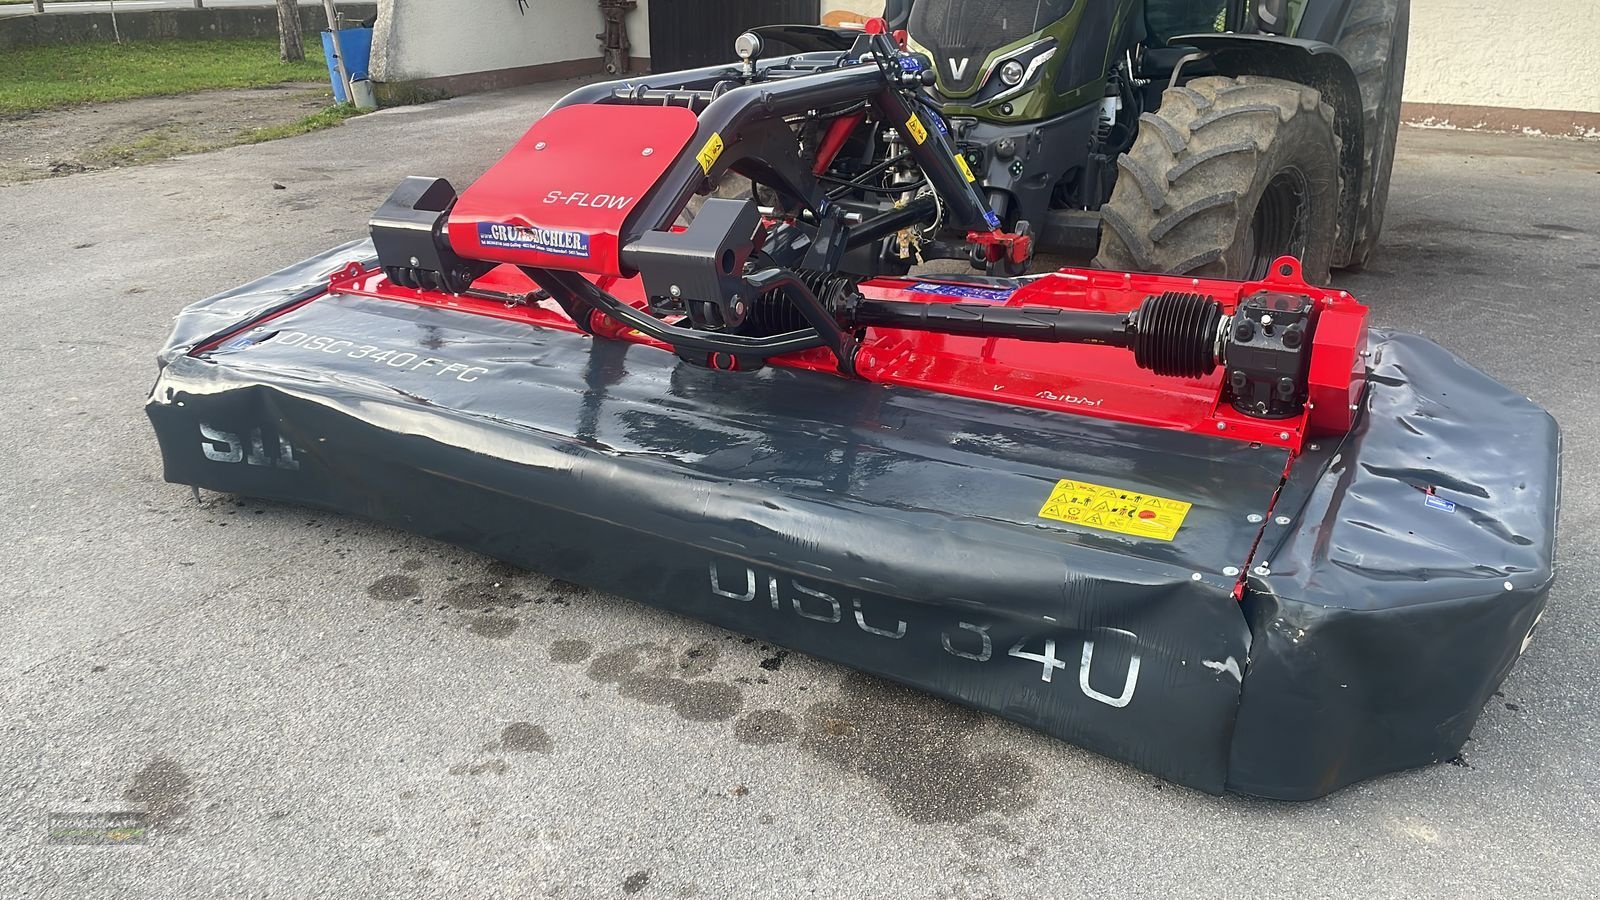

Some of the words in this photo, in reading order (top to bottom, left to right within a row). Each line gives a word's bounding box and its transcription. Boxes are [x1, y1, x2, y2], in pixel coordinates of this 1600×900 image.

[948, 57, 969, 81] V
[542, 190, 634, 211] S-FLOW
[275, 331, 355, 354] DISC
[346, 344, 419, 368] 340
[410, 357, 445, 371] F
[436, 362, 489, 383] FC
